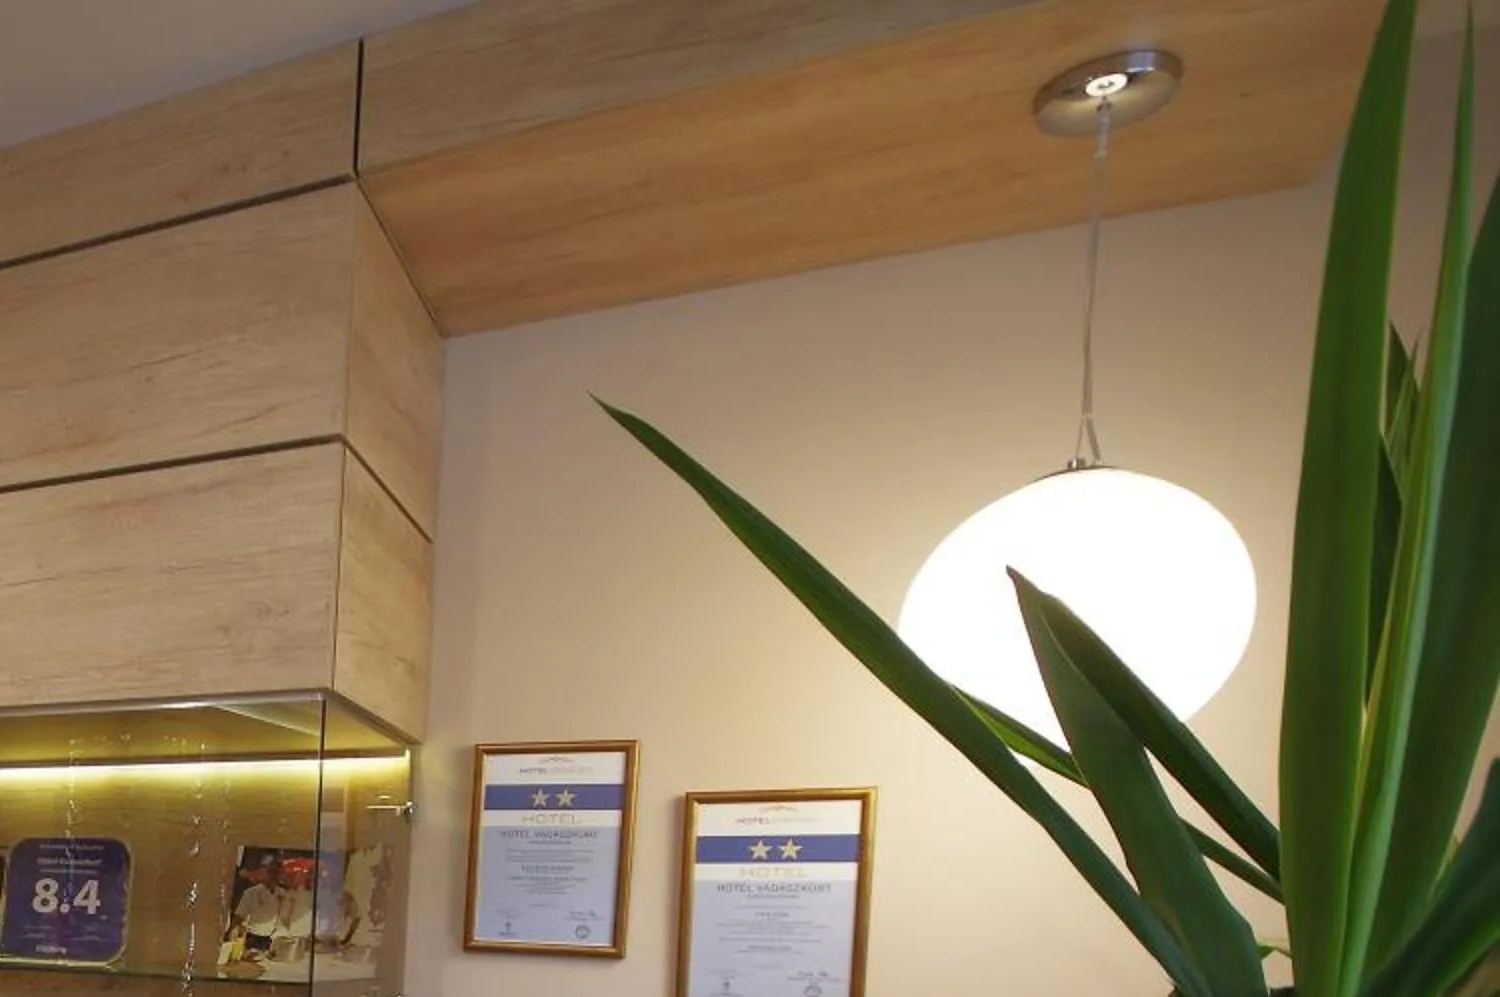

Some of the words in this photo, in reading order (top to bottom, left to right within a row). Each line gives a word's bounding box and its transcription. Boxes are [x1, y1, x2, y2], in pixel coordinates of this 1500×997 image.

[521, 813, 581, 825] HOTEL
[739, 866, 806, 878] HOTEL
[716, 883, 753, 894] HOTEL
[31, 877, 101, 915] 8.4
